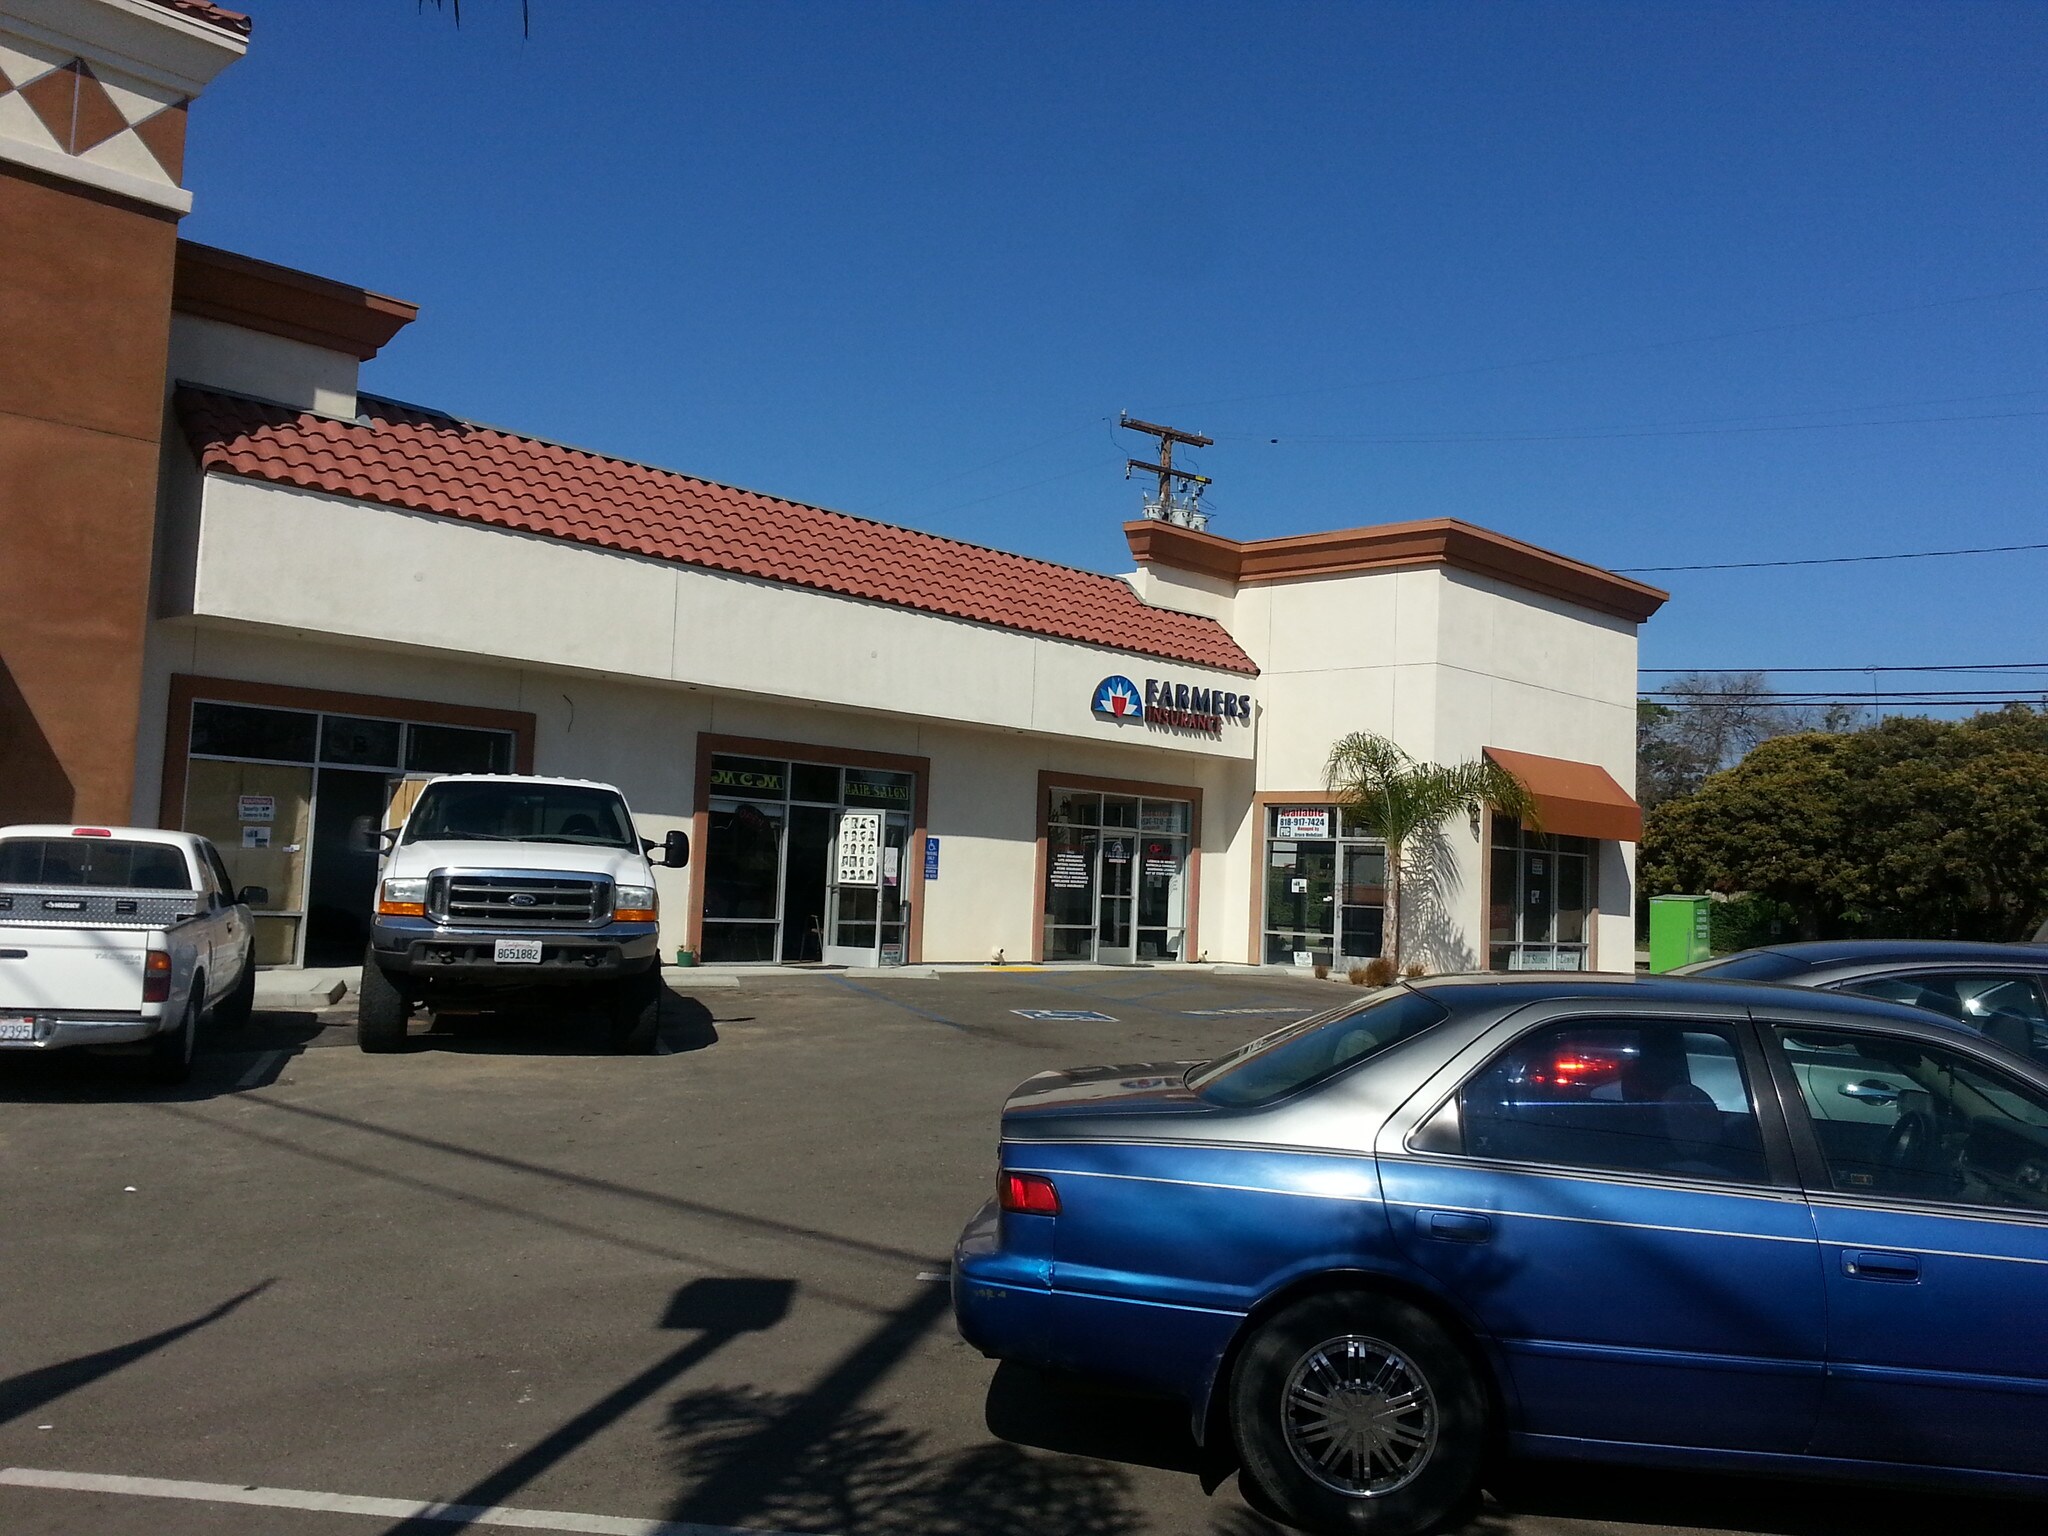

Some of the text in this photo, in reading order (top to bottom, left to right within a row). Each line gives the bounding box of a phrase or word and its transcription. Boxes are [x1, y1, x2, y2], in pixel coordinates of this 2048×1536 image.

[1145, 678, 1251, 719] FARMERS
[1145, 705, 1223, 733] INSURANCE
[874, 785, 906, 799] SALON
[1280, 807, 1324, 817] Available
[1280, 818, 1324, 826] 818-917-7424
[498, 949, 538, 959] 8G51882
[0, 1025, 31, 1039] 9395
